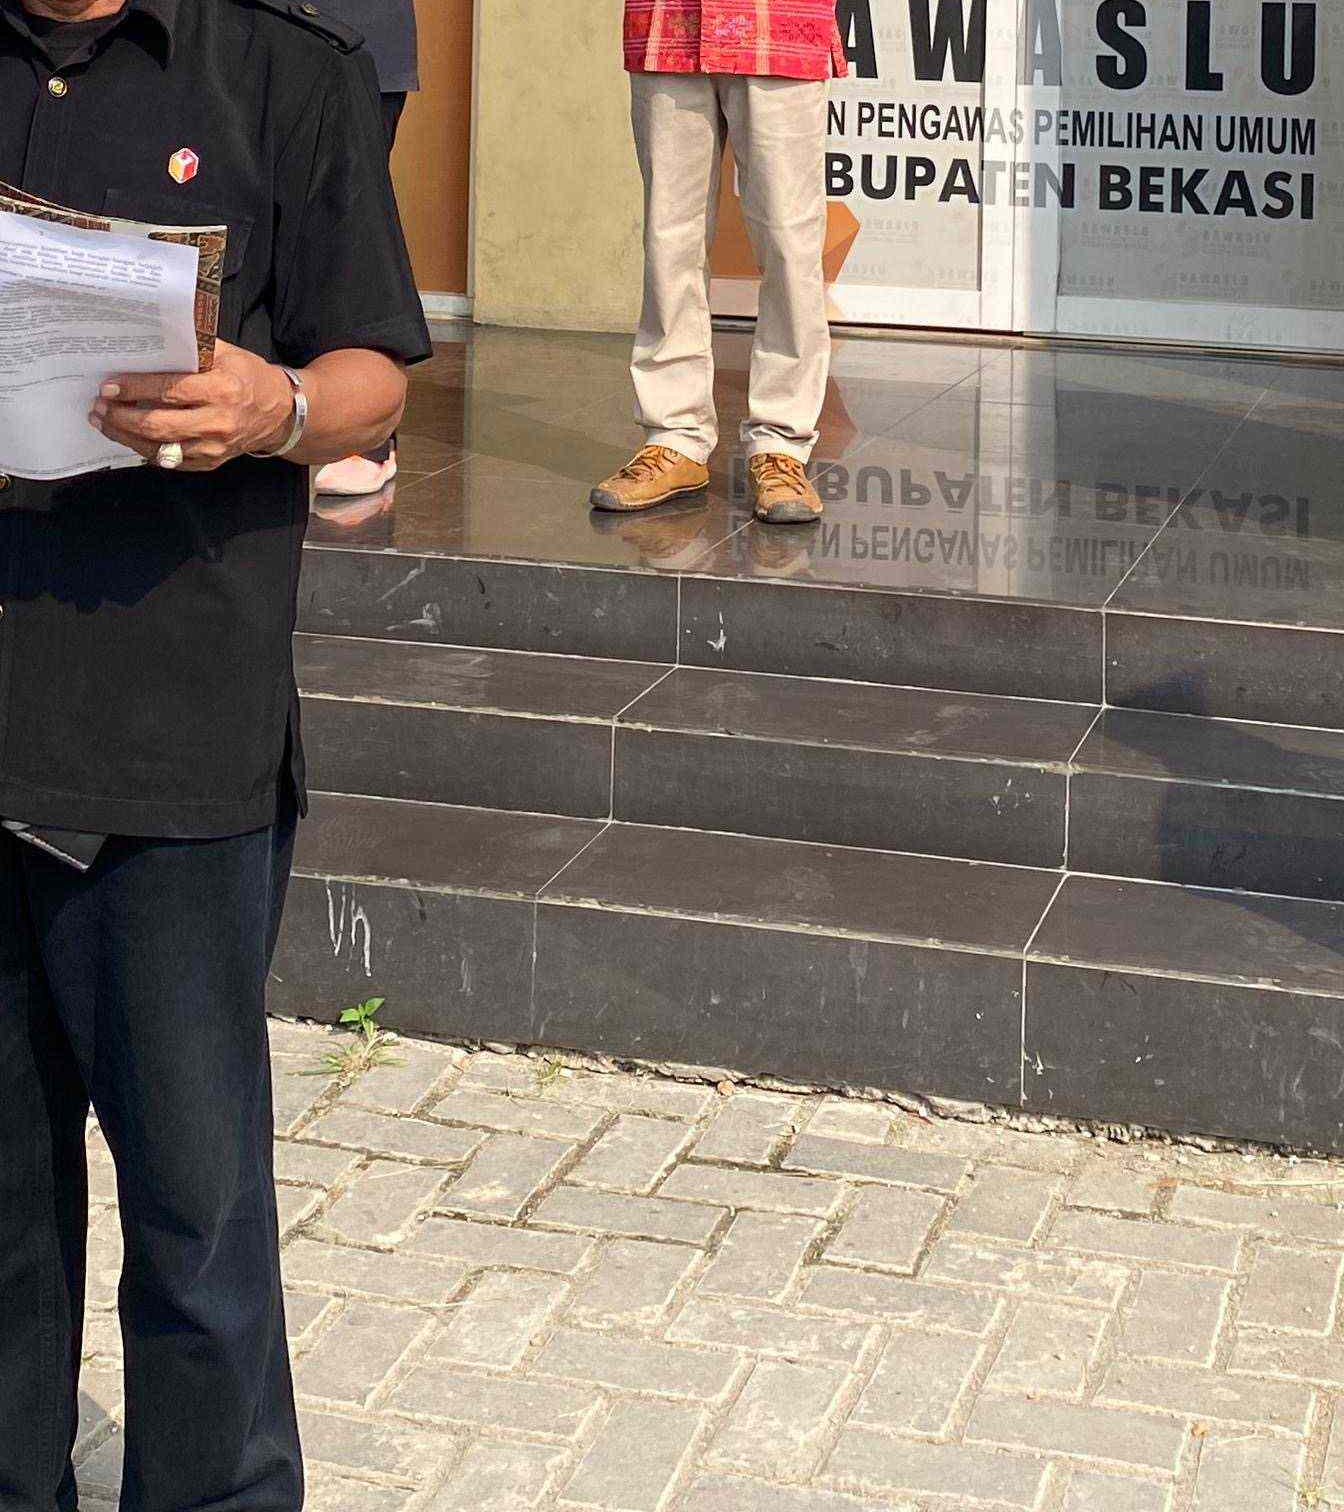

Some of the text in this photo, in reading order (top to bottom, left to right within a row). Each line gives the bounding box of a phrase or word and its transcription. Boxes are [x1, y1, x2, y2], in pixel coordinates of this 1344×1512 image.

[856, 101, 1024, 145] PENGAWAS
[1035, 109, 1203, 152] PEMILIHAN
[1216, 117, 1317, 155] UMUM
[825, 152, 1315, 220] BUPATEN BEKASI
